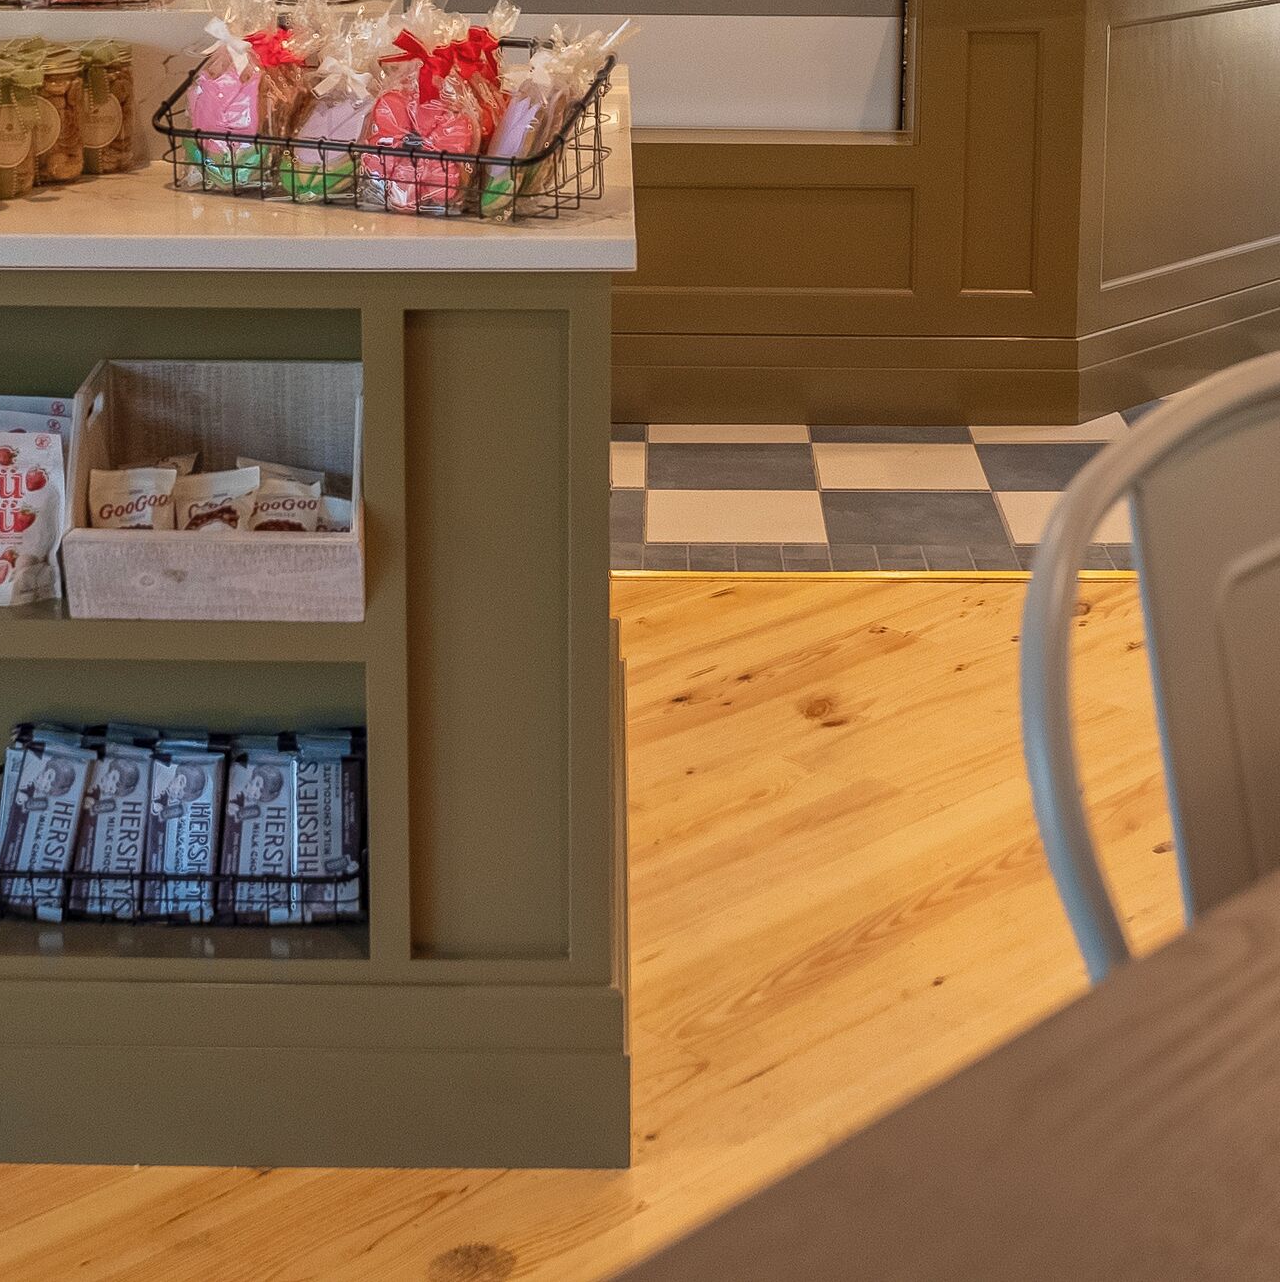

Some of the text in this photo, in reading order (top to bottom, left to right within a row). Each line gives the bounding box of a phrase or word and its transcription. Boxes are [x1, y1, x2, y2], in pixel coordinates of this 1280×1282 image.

[323, 765, 332, 827] CHOCOLATE
[104, 815, 116, 843] MILK
[250, 822, 260, 849] MILK
